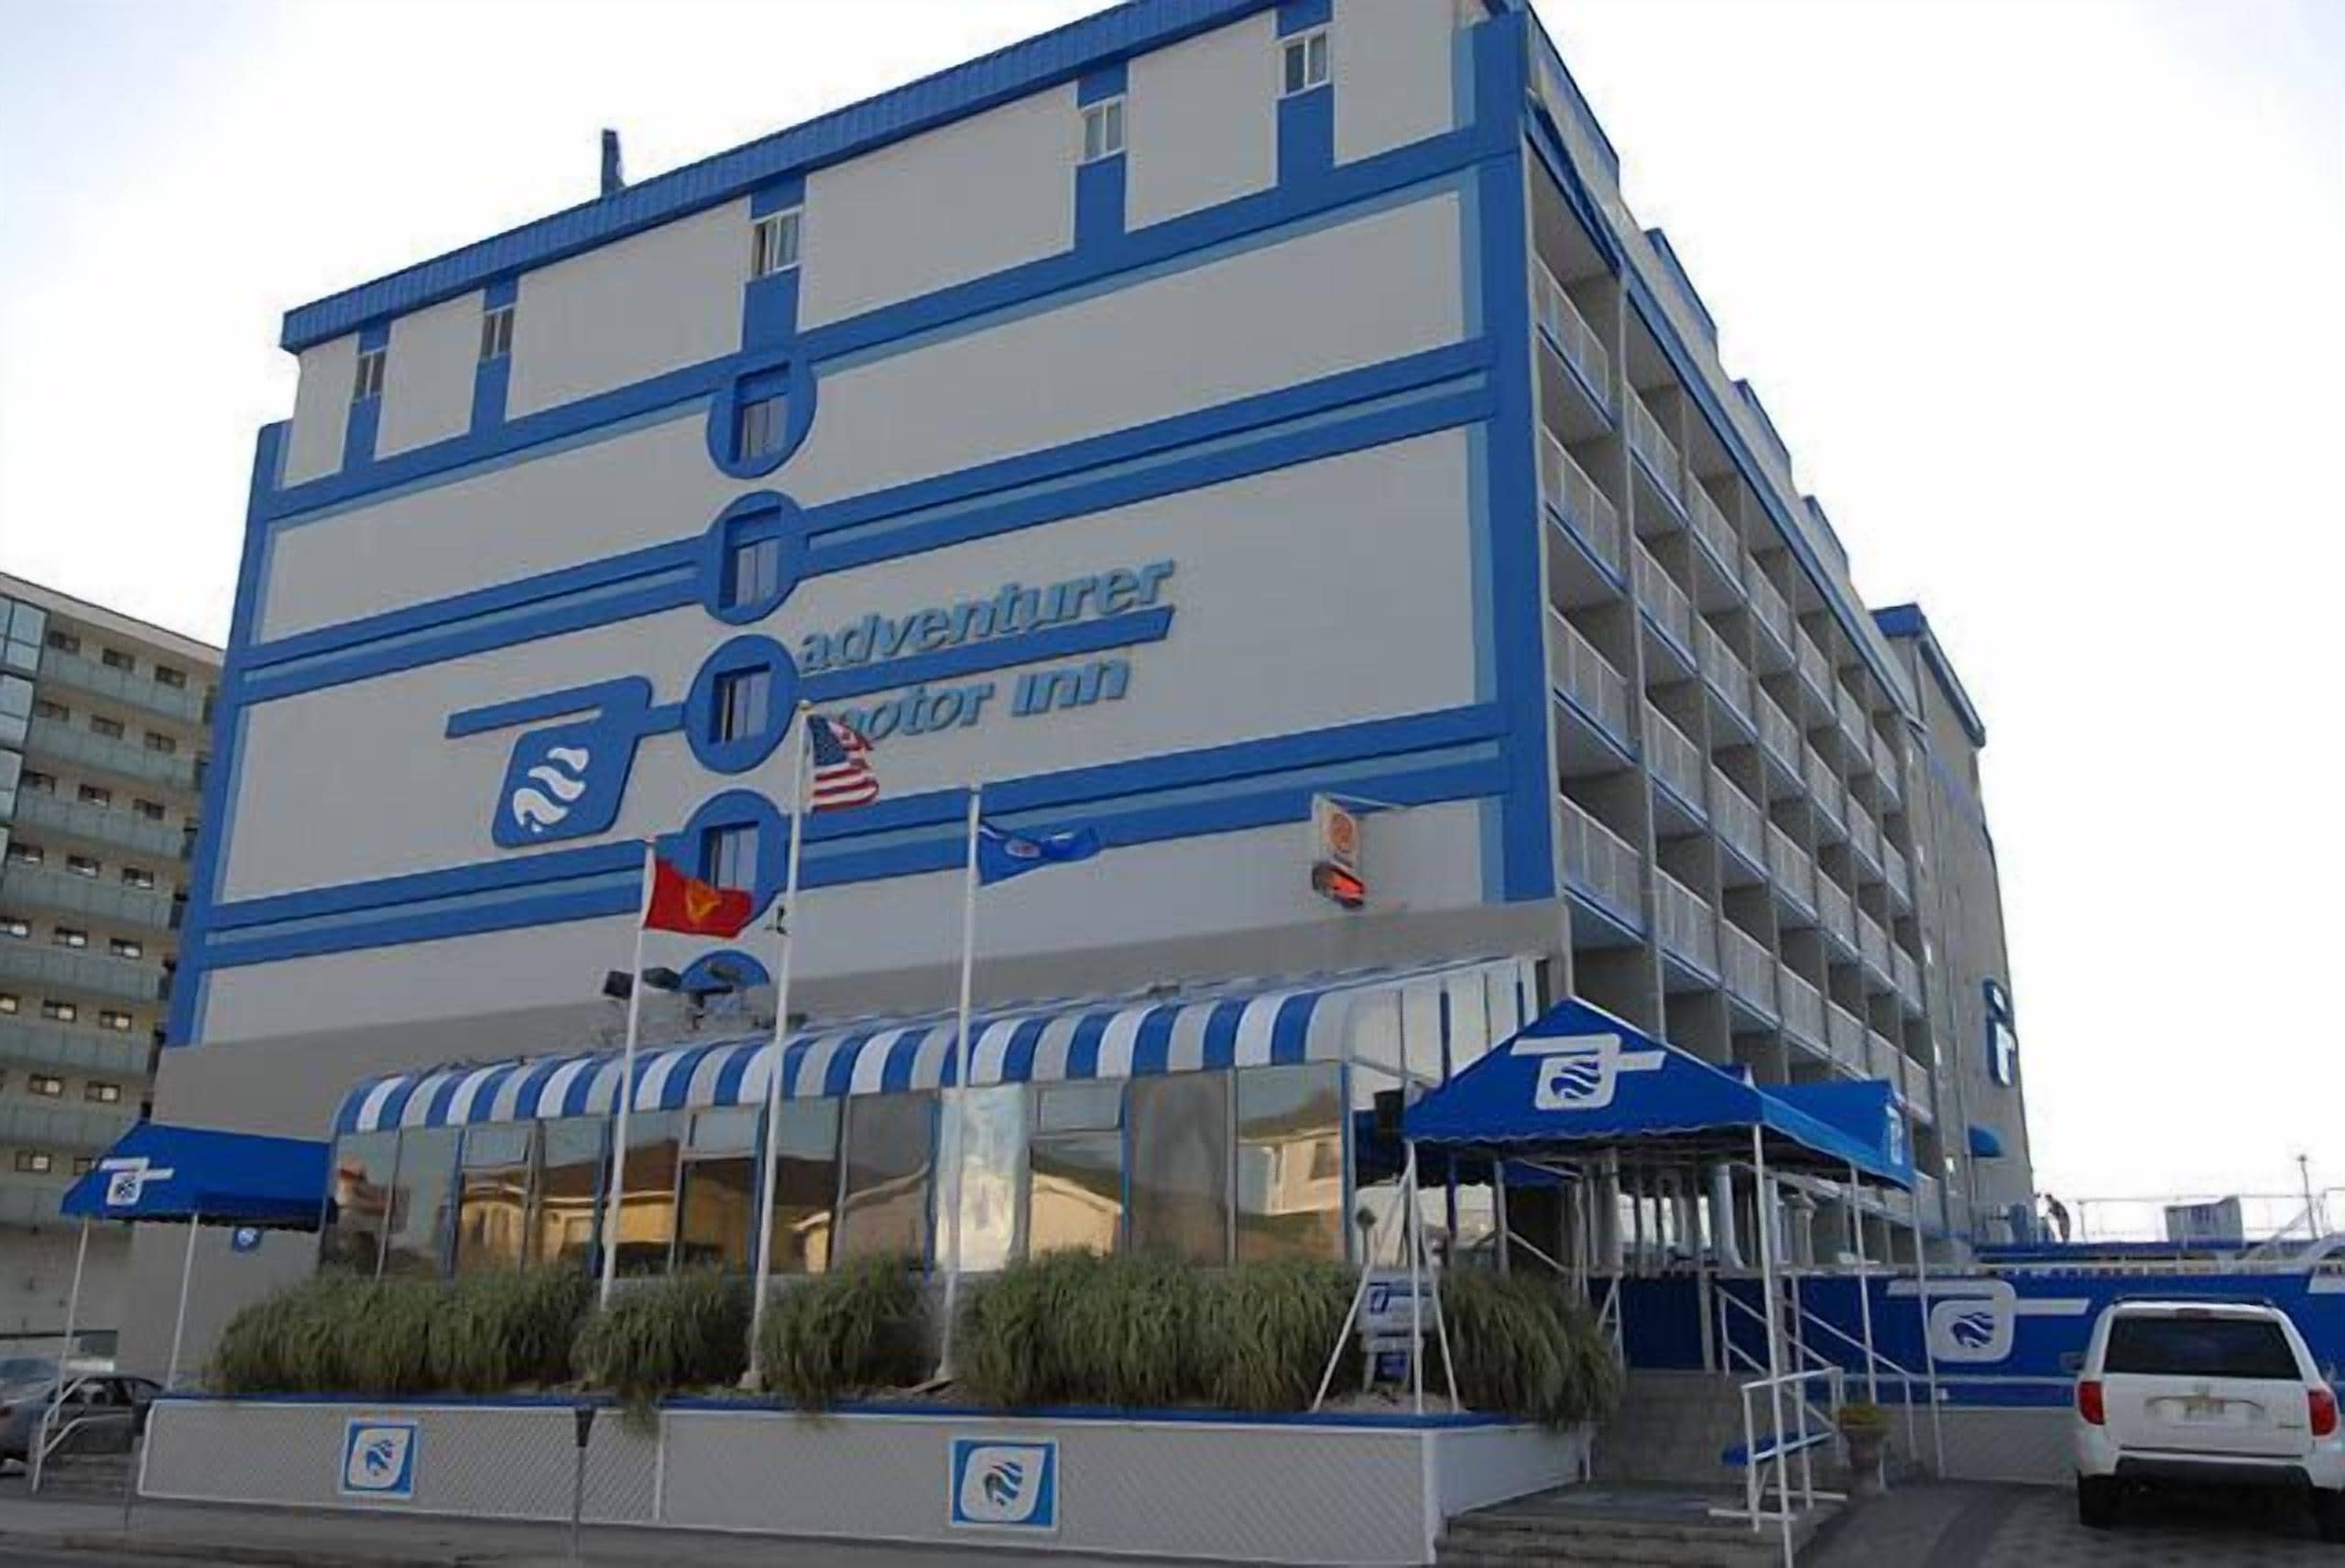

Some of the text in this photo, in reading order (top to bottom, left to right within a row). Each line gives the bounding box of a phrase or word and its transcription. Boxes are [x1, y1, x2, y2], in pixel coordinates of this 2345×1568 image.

[799, 560, 1174, 672] adventurer
[843, 658, 1132, 742] otor inn
